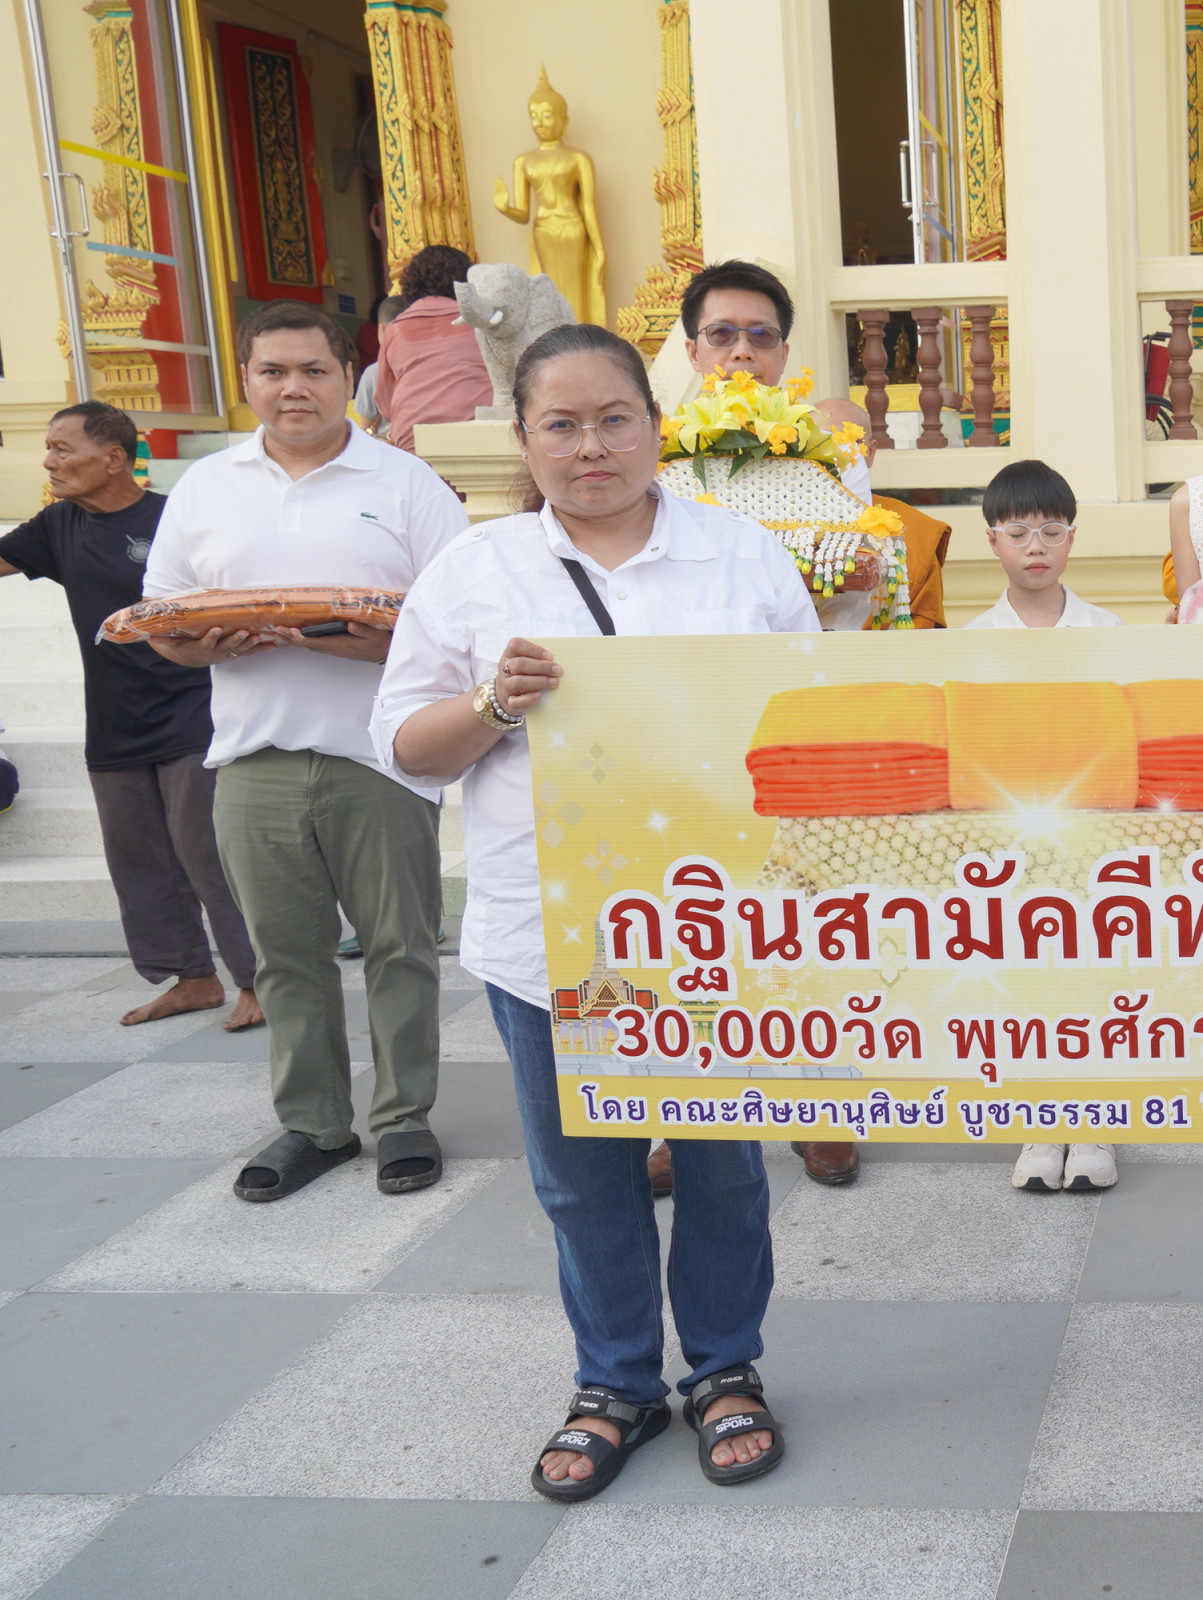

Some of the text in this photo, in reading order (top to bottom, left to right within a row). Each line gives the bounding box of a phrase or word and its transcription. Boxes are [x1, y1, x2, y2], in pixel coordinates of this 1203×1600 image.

[613, 995, 922, 1070] 30,000วัด
[580, 1085, 646, 1121] โดย
[661, 1089, 945, 1137] คณะศิษยานุศิษย์
[960, 1102, 1128, 1137] บูชาธรรม
[1145, 1098, 1189, 1125] 81
